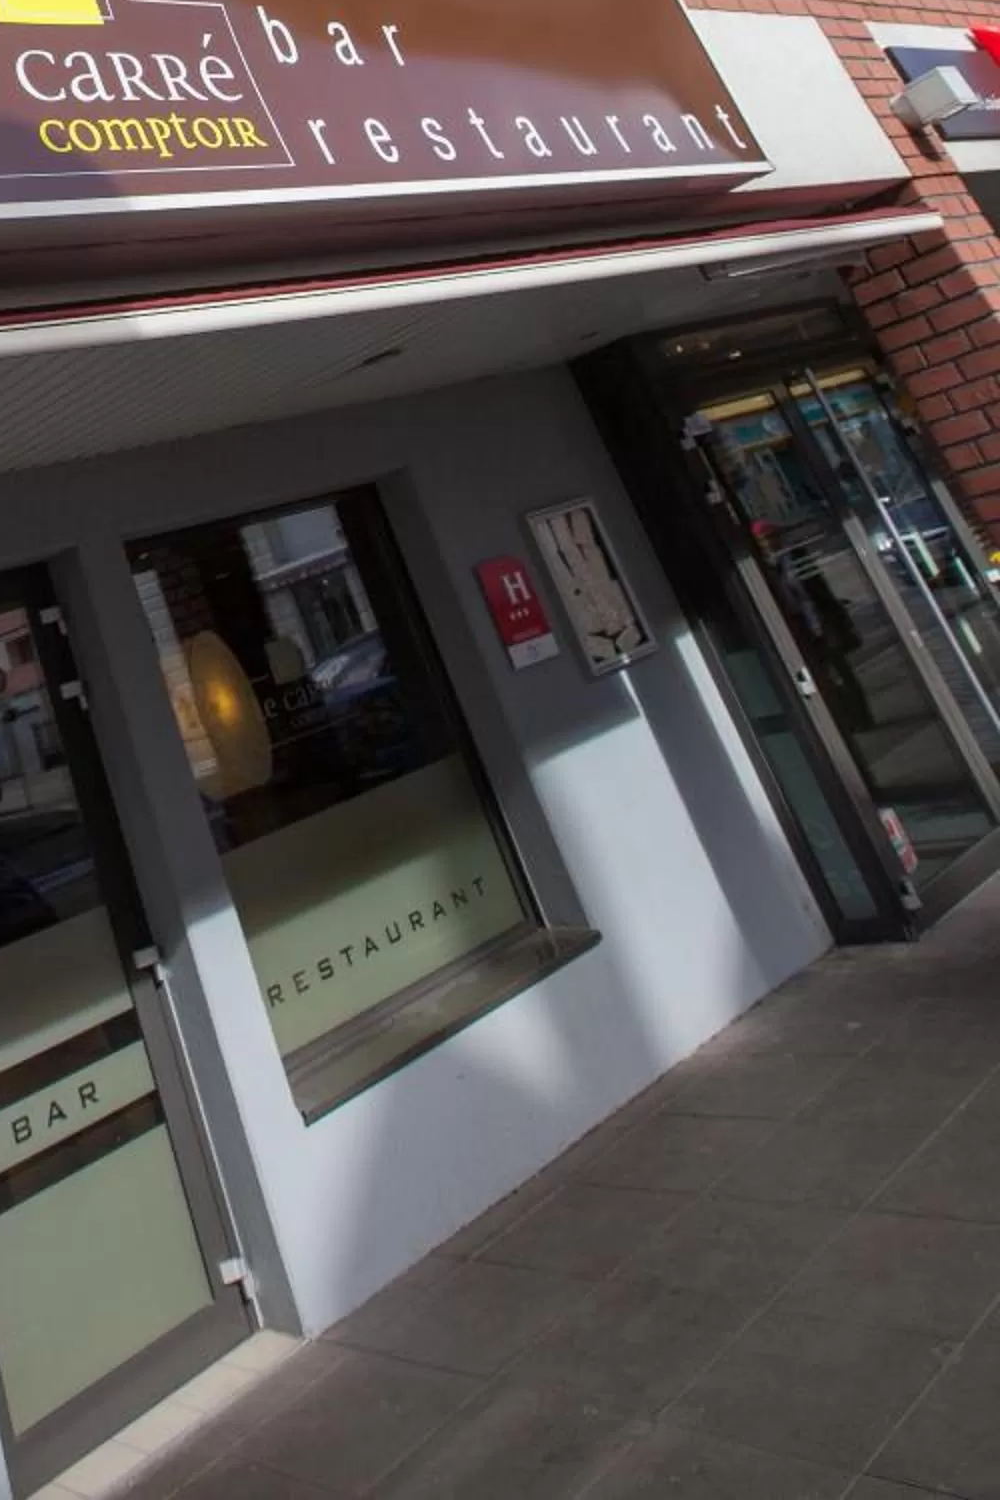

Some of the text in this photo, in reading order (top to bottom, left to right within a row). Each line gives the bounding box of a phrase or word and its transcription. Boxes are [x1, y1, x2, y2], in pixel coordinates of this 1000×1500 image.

[256, 5, 405, 66] bar
[306, 104, 747, 165] restaurant
[266, 877, 489, 1009] RESTAURANT
[10, 1080, 99, 1147] BAR
